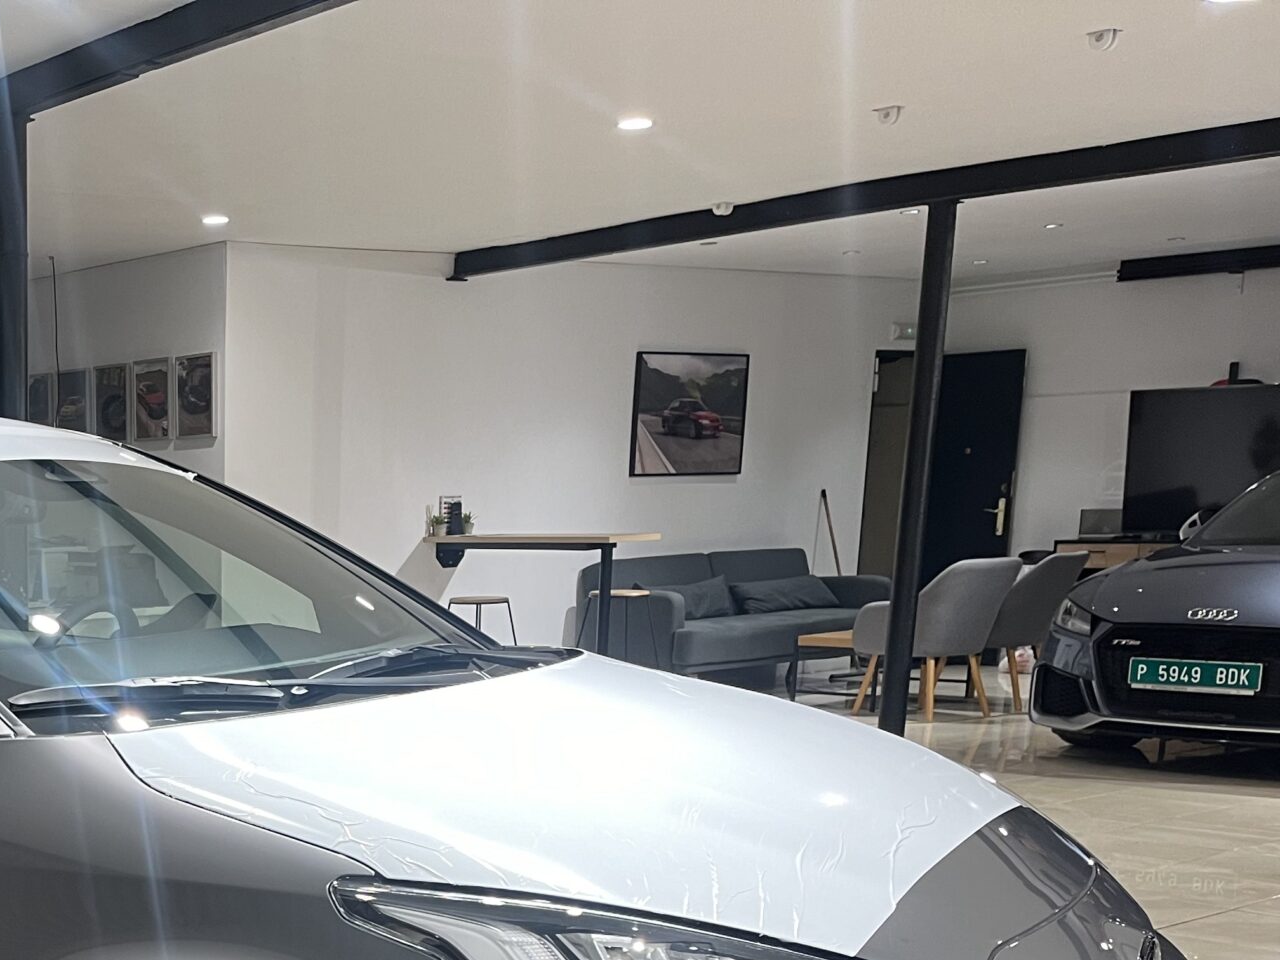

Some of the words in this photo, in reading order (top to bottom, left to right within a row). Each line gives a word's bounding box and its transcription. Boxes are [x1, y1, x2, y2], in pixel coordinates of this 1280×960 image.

[1137, 664, 1147, 681] P
[1158, 665, 1201, 683] 5949
[1215, 667, 1250, 686] BDK
